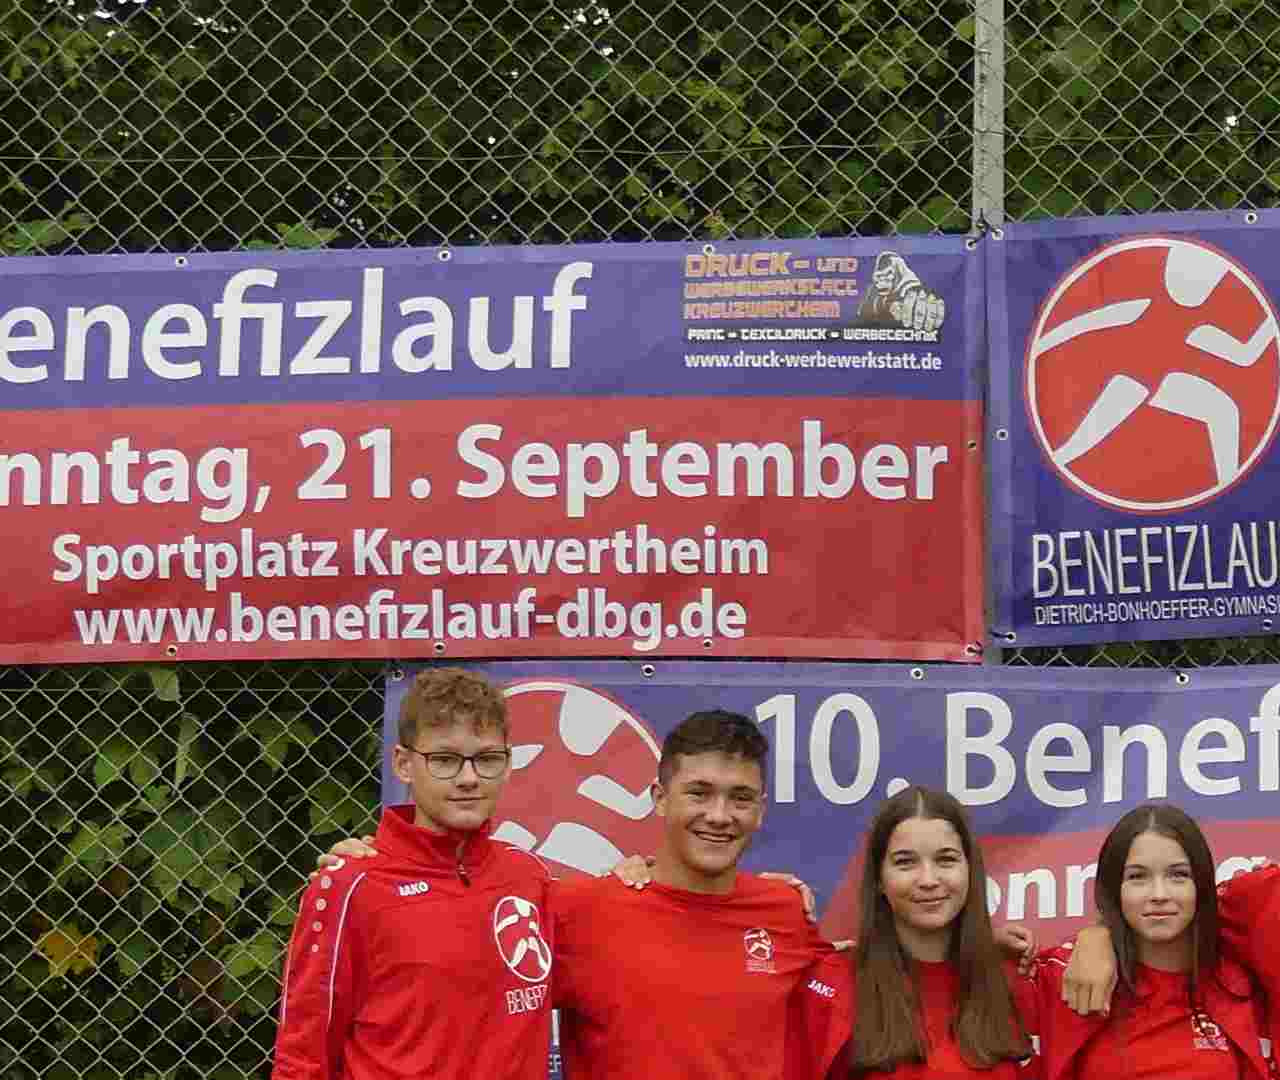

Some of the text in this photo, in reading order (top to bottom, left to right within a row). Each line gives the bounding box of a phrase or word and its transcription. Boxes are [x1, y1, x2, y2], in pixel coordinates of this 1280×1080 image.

[0, 262, 593, 384] enefizlauf
[684, 350, 943, 371] www.druck-werbewerkstatt.de
[297, 428, 431, 500] 21.
[456, 420, 948, 518] September
[53, 524, 770, 594] Sportplatz Kreuzwertheim
[74, 588, 748, 651] www.benefizlauf-dbg.de
[754, 692, 910, 806] 10.
